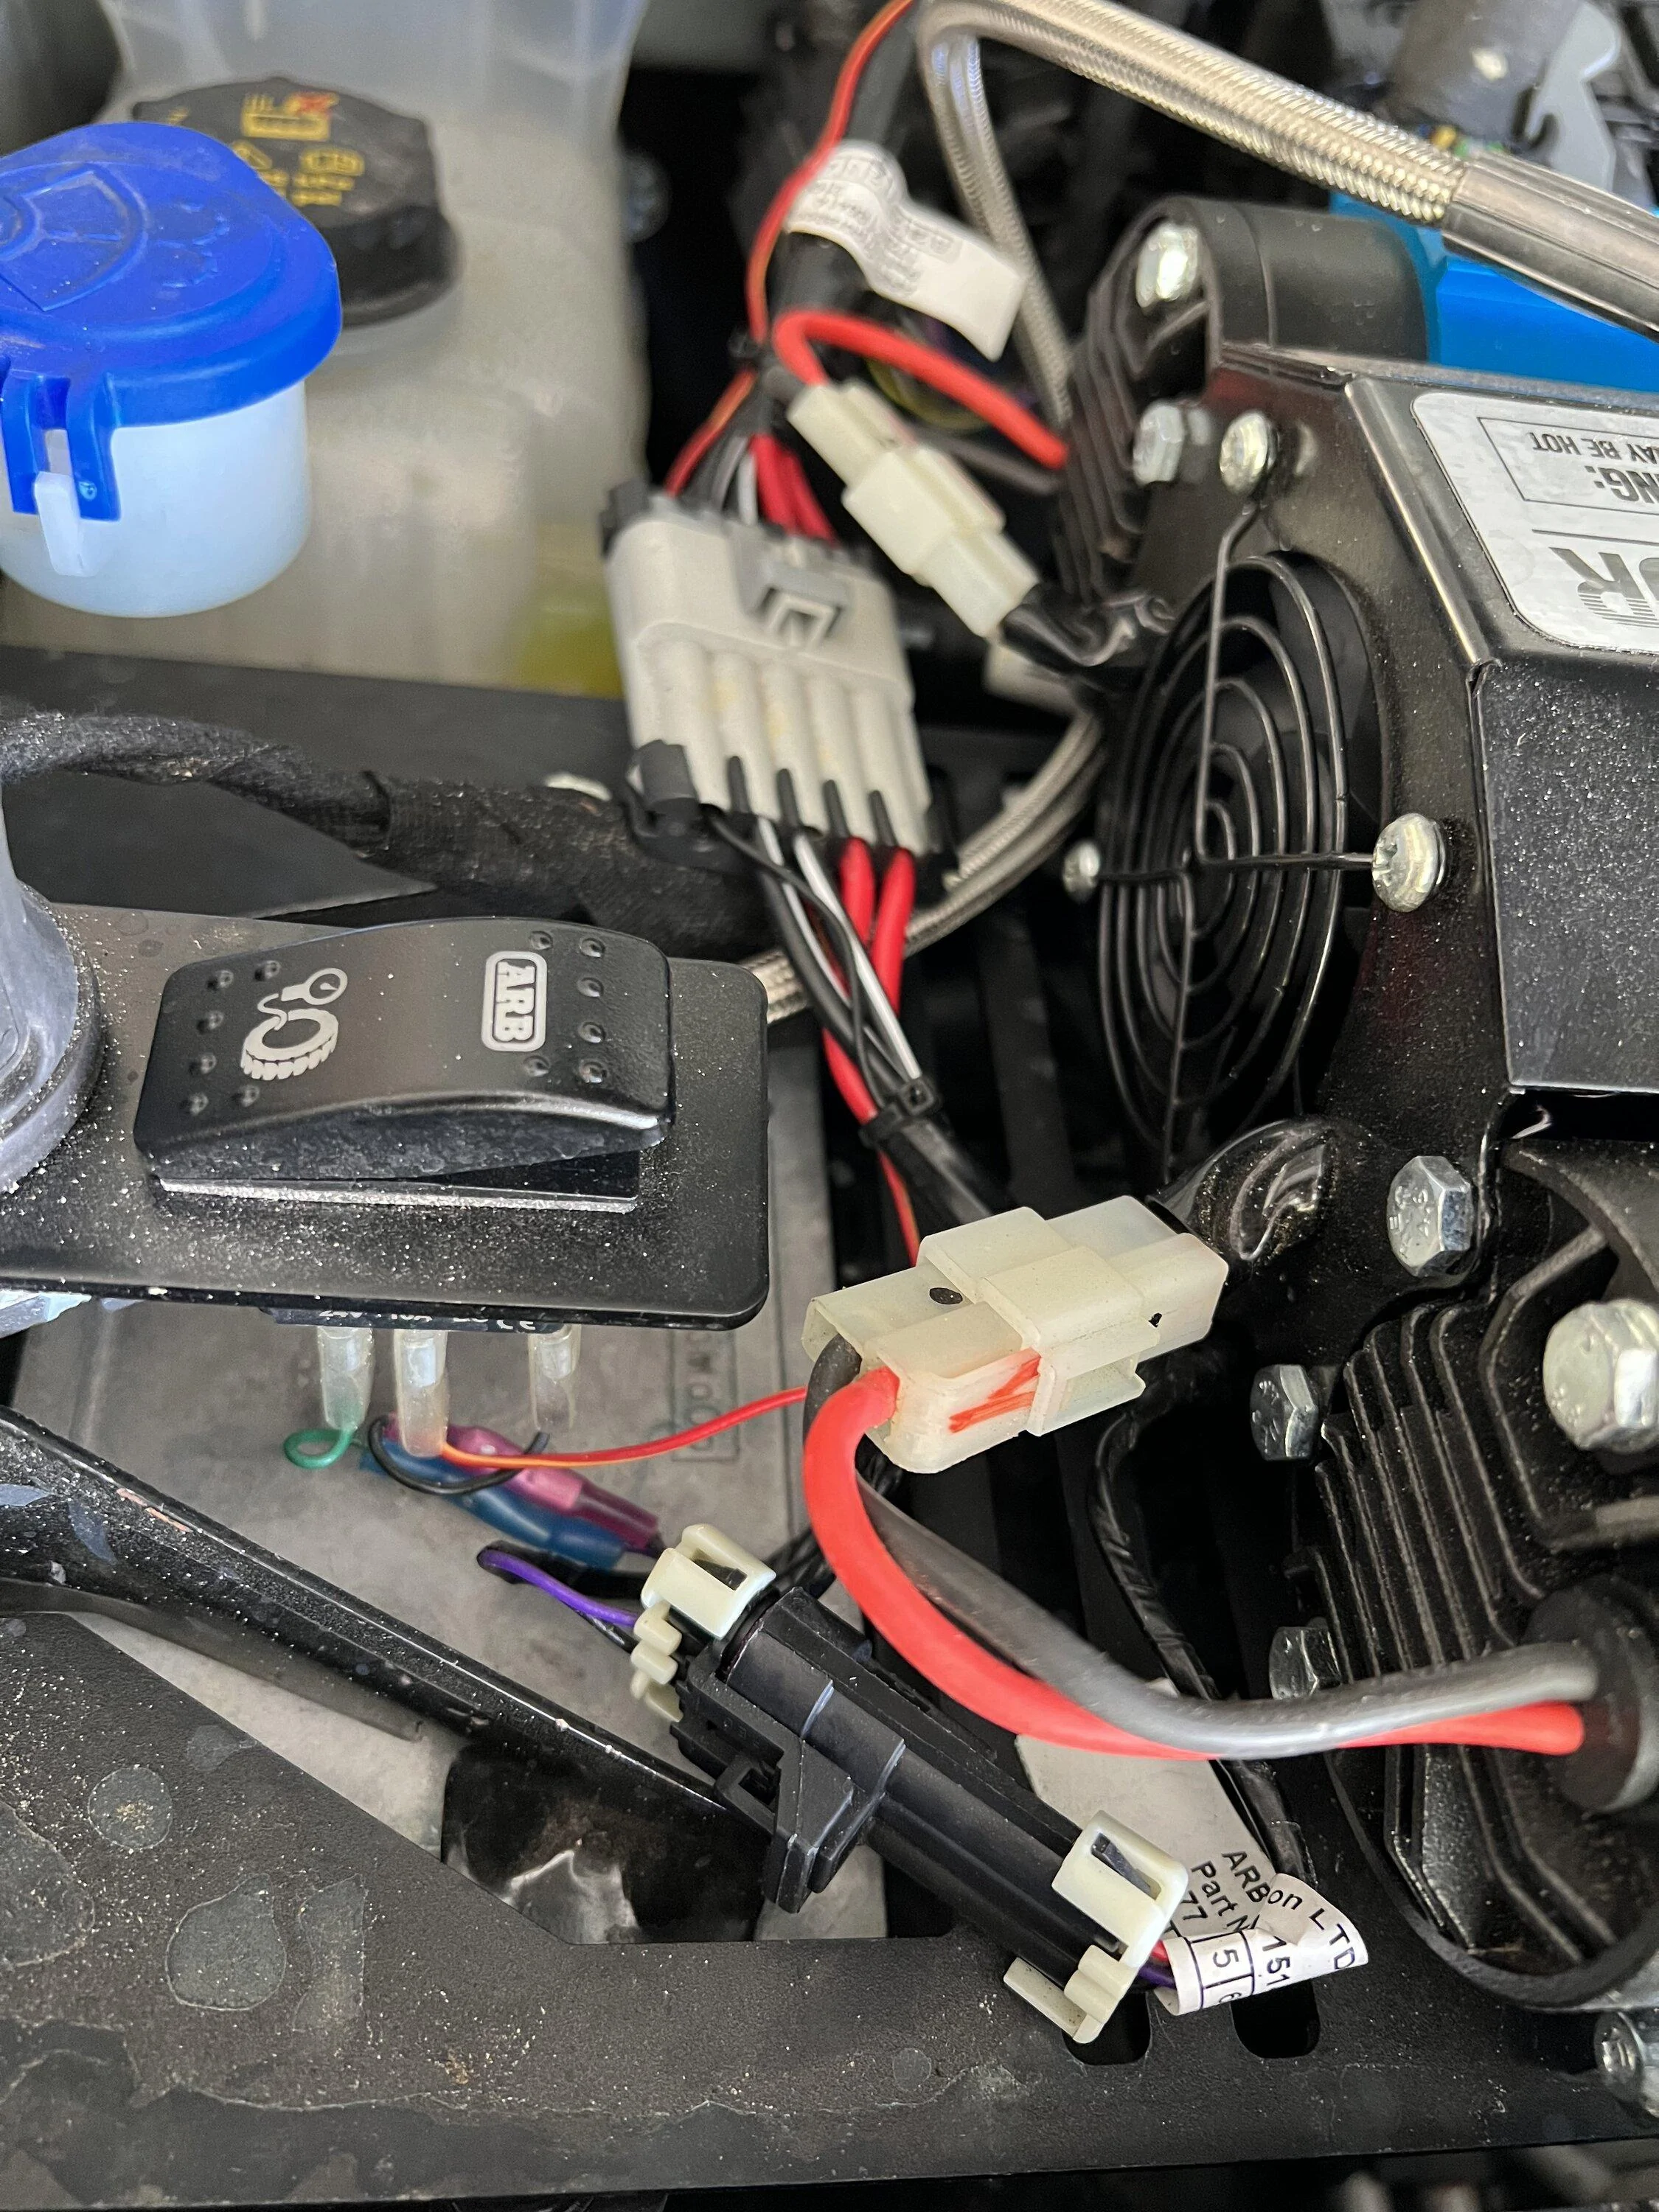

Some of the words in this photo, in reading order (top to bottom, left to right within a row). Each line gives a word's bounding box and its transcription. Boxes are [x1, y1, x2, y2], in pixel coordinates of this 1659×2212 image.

[1529, 432, 1582, 456] HOT
[1581, 438, 1622, 461] BE
[1625, 442, 1659, 465] AY
[1585, 465, 1659, 504] NG:
[495, 959, 535, 1041] ARB
[1191, 1860, 1238, 1917] Part
[1213, 1949, 1239, 1968] 5
